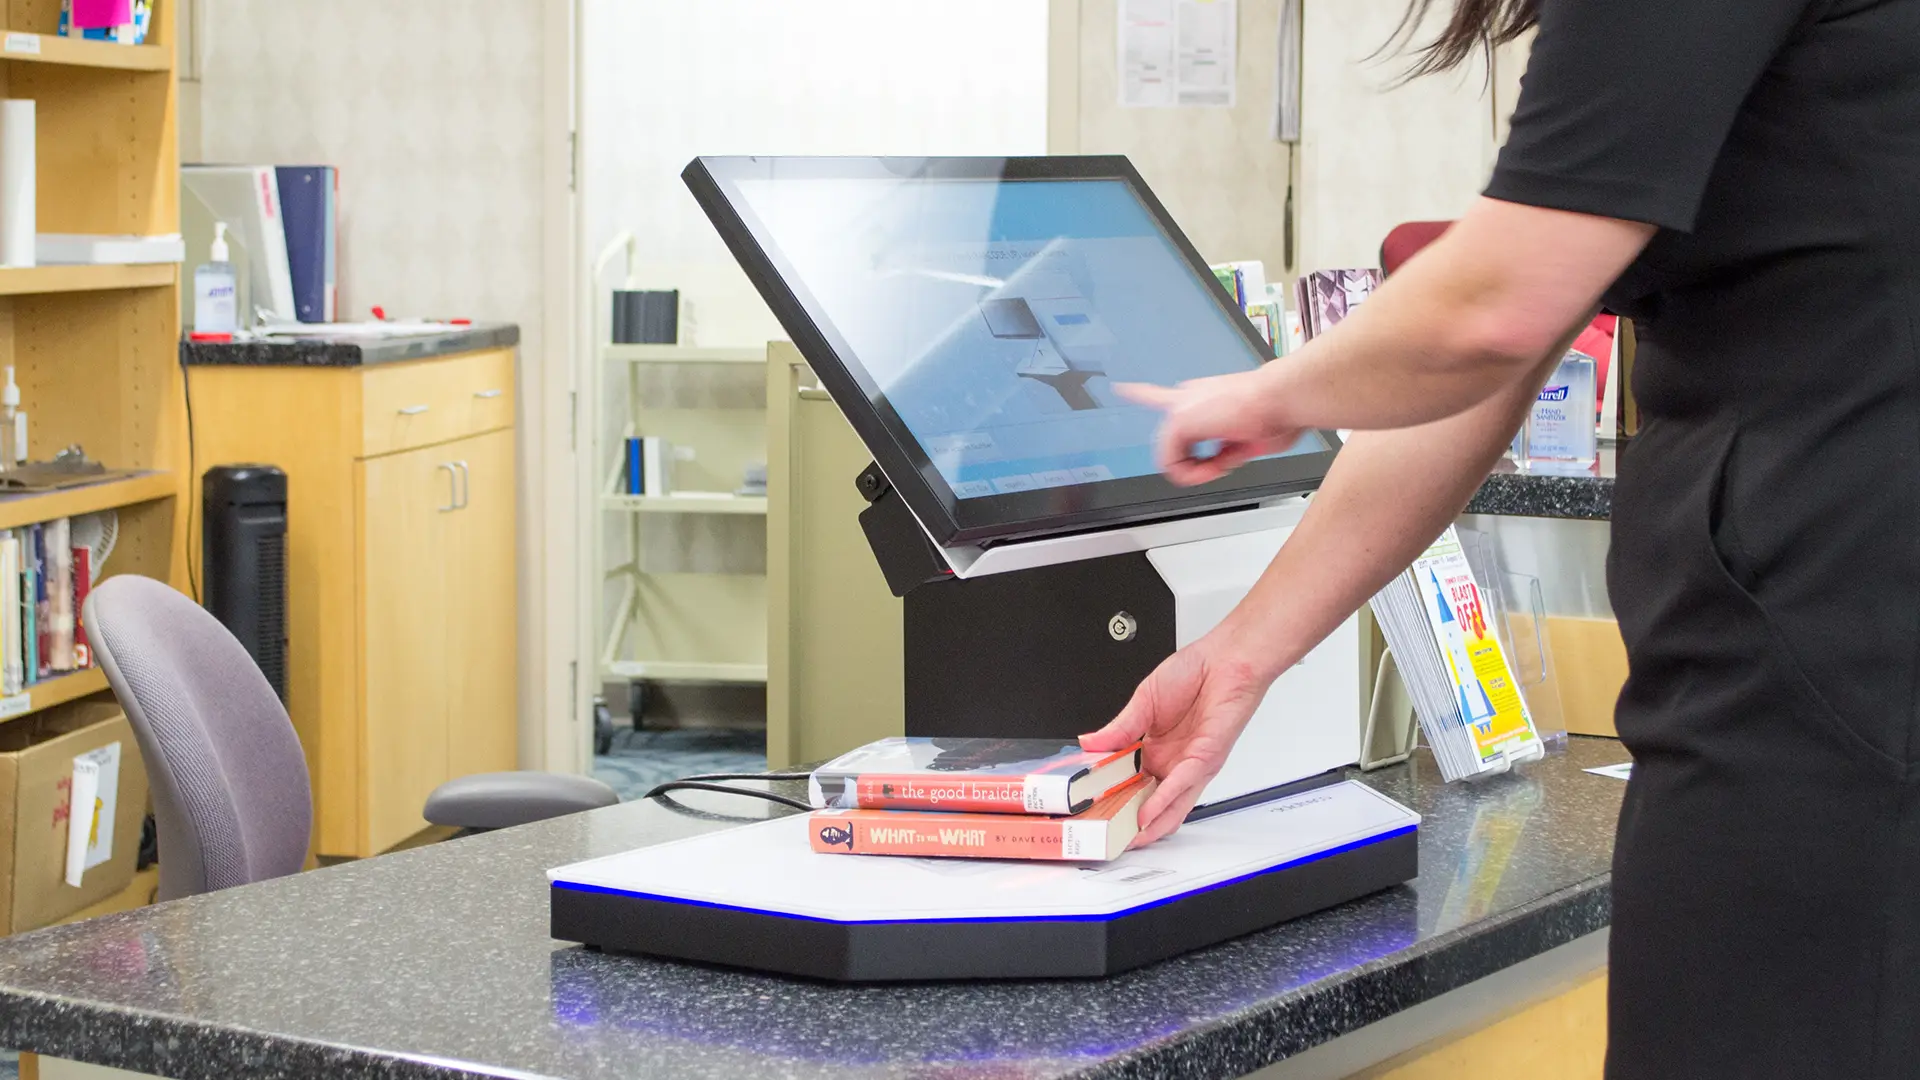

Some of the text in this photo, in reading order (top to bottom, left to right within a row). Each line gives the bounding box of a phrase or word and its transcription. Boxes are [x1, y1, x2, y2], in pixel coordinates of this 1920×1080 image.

[1539, 389, 1565, 400] urell
[1451, 583, 1472, 603] BLAST
[902, 781, 925, 799] the
[930, 782, 966, 804] good
[870, 827, 917, 845] WHAT
[939, 828, 987, 847] WHAT
